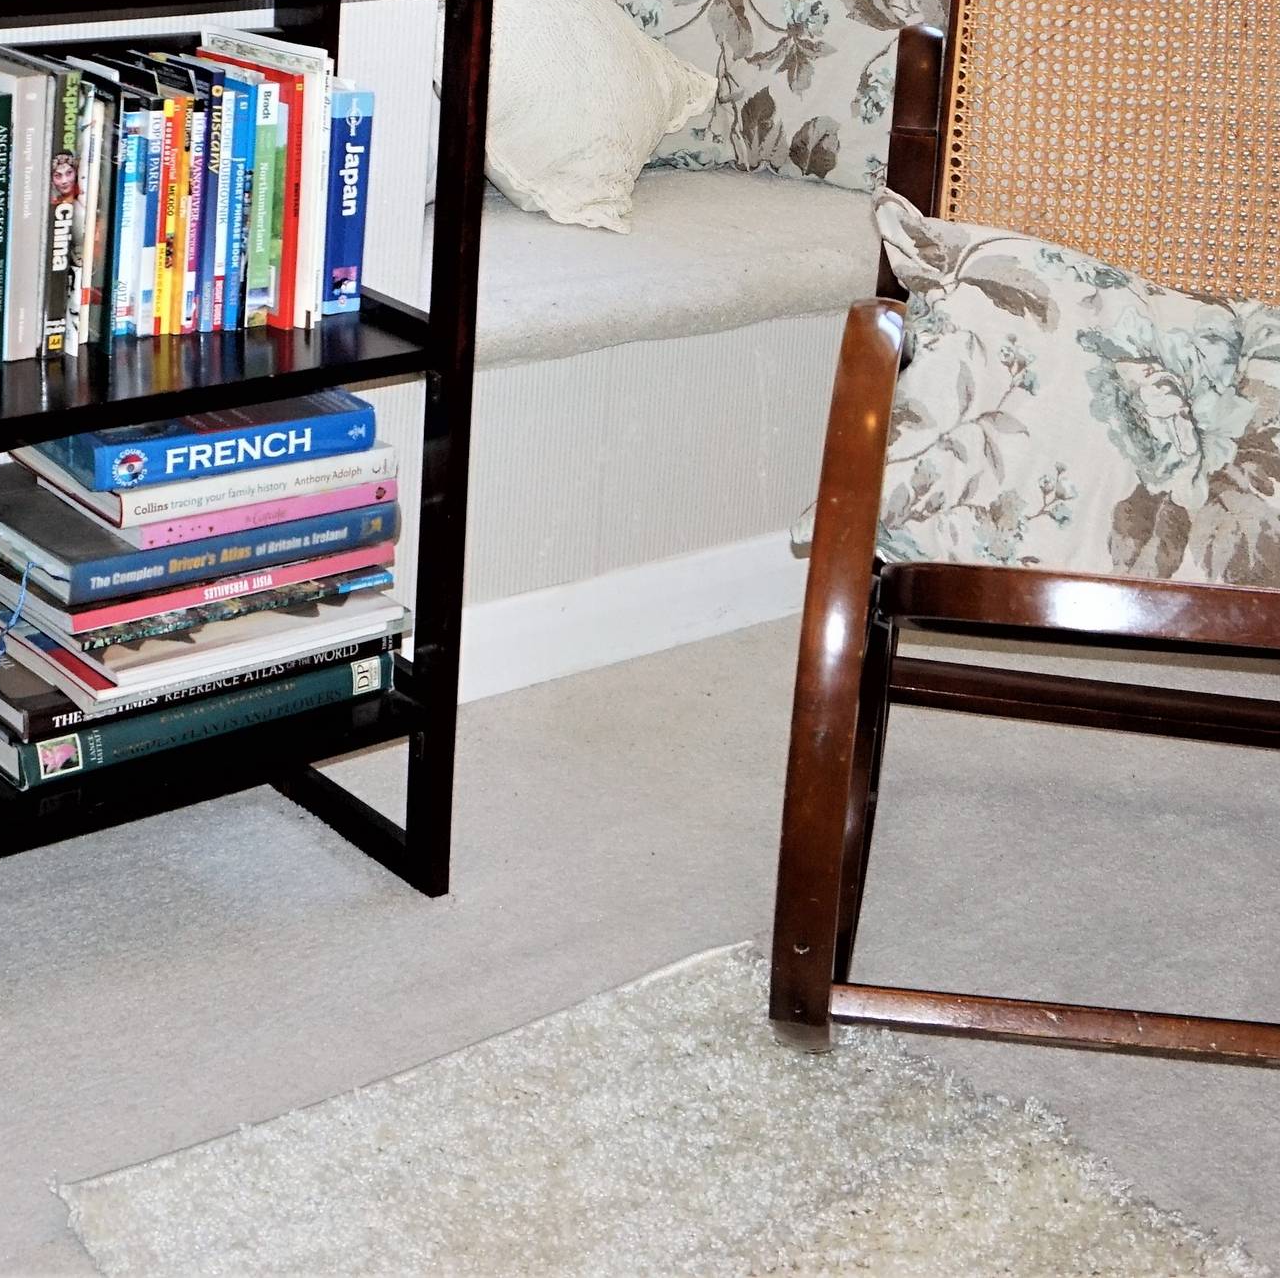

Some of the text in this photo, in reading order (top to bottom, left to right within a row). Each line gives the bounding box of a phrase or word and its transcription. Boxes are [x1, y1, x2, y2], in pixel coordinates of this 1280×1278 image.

[52, 72, 79, 271] Explorer China
[207, 103, 222, 173] Tuscany
[218, 97, 234, 224] EXPLORE DUBROVNIK
[255, 162, 269, 252] Northumberland
[339, 142, 365, 216] Japan
[231, 163, 244, 268] POCKET PHRASE BOOK
[165, 427, 313, 475] FRENCH
[294, 466, 363, 488] Anthony Adolph
[134, 480, 288, 516] Collins tracing your family history
[203, 573, 274, 599] VISIT VERSAILLES
